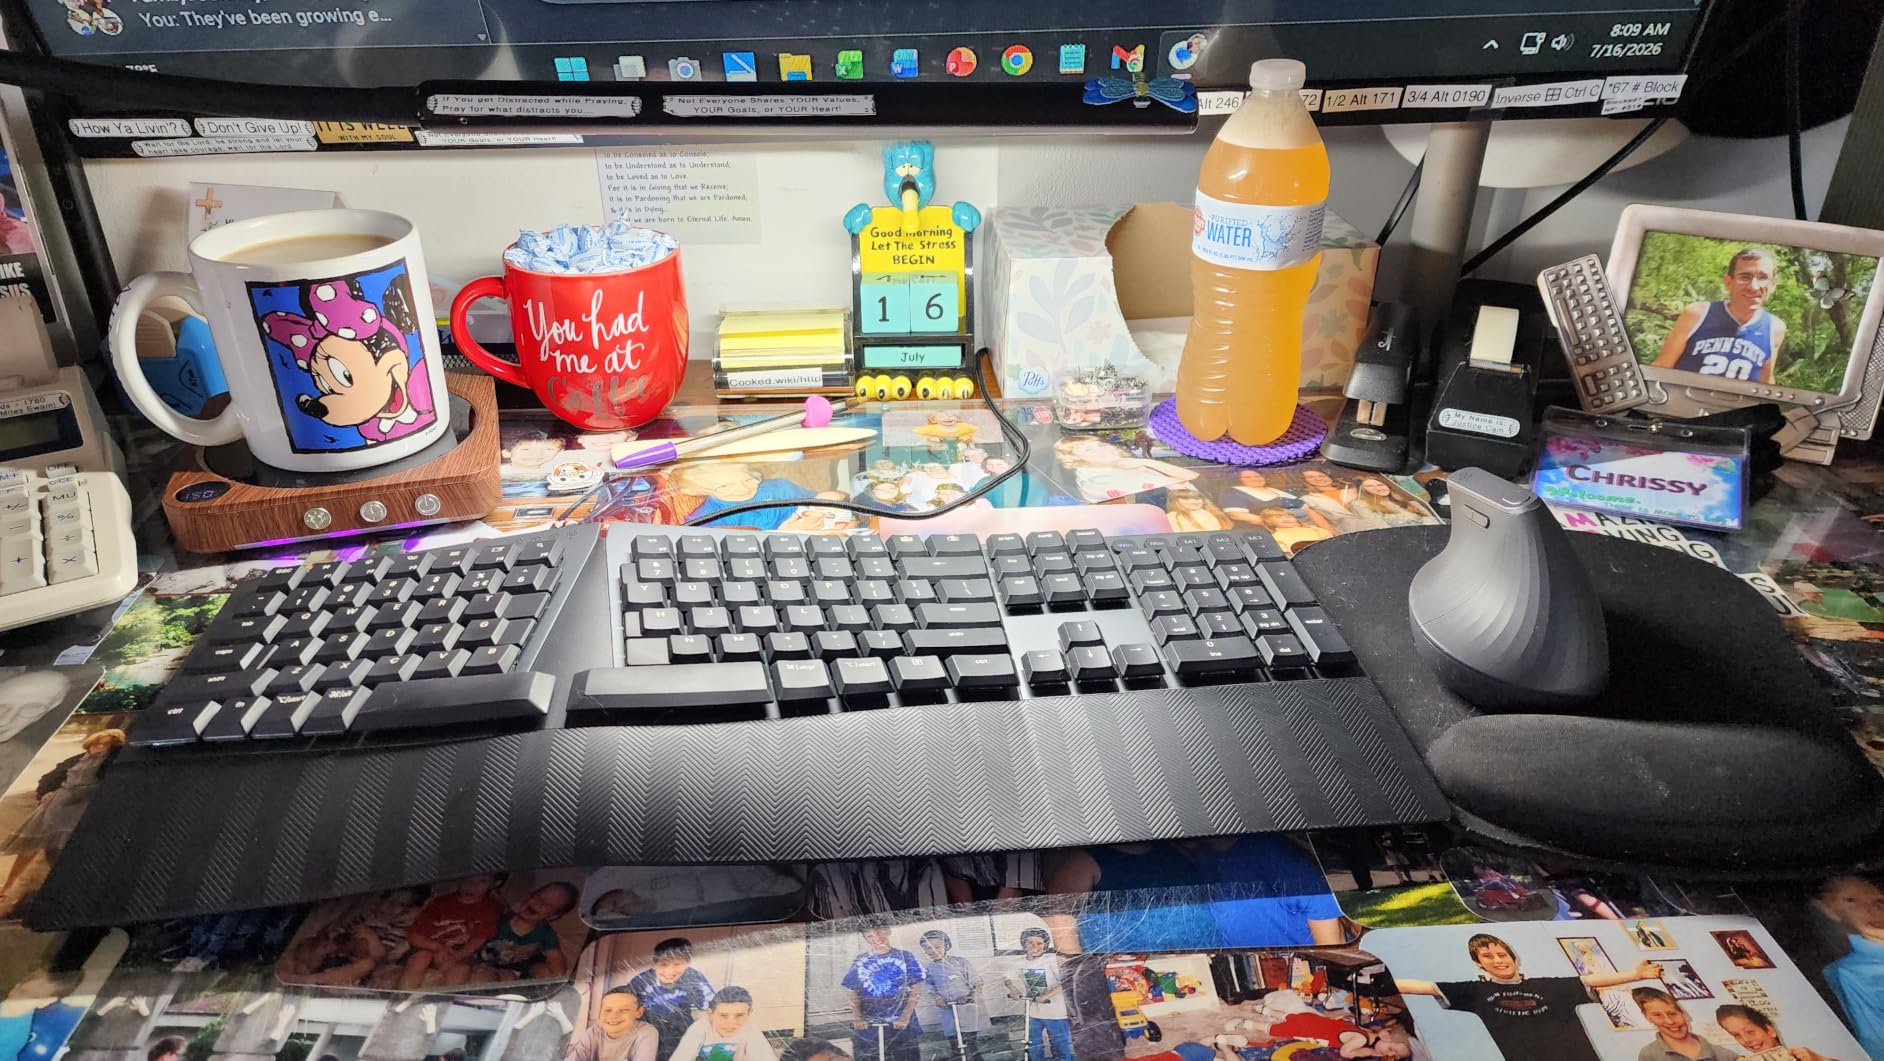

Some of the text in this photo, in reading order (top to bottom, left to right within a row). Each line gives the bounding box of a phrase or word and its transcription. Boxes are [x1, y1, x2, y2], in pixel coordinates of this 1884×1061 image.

[138, 12, 180, 27] You:
[180, 10, 246, 29] They've
[248, 9, 293, 25] been
[296, 8, 364, 27] growing
[1610, 23, 1671, 37] 8:09 AM
[1589, 43, 1663, 58] 7/16/2026
[1644, 81, 1679, 93] Block
[699, 97, 746, 105] Everyone
[1303, 94, 1317, 106] 72
[1326, 92, 1395, 107] 1/2 Alt 171
[1407, 89, 1486, 103] 3/4 Alt 0190
[1496, 85, 1600, 105] Inverse Ctrl C
[1216, 98, 1240, 109] 246
[81, 122, 177, 135] How Ya Livin'?
[207, 121, 301, 135] Don't Give Up!
[649, 183, 671, 193] Giving
[674, 183, 687, 191] that
[634, 195, 671, 204] Pardoning
[687, 215, 712, 223] Eternal
[1211, 214, 1249, 226] PURIFIED
[870, 225, 953, 239] Good orning
[1207, 220, 1252, 248] WATER
[871, 239, 956, 251] Let The Stress
[893, 255, 935, 265] BEGIN
[878, 292, 944, 323] 1 6
[523, 289, 649, 362] You had
[550, 340, 645, 374] me at
[900, 352, 925, 363] July
[1691, 337, 1766, 367] PENN STATE
[1699, 354, 1753, 381] 20
[1023, 372, 1045, 386] Puffs
[27, 402, 56, 412] Swam!
[1454, 412, 1465, 420] My
[1469, 415, 1493, 424] Name
[1451, 420, 1481, 430] Justice
[48, 463, 71, 472] OFF
[1565, 464, 1707, 497] CHRISSY
[52, 492, 76, 500] MU
[393, 603, 401, 611] E
